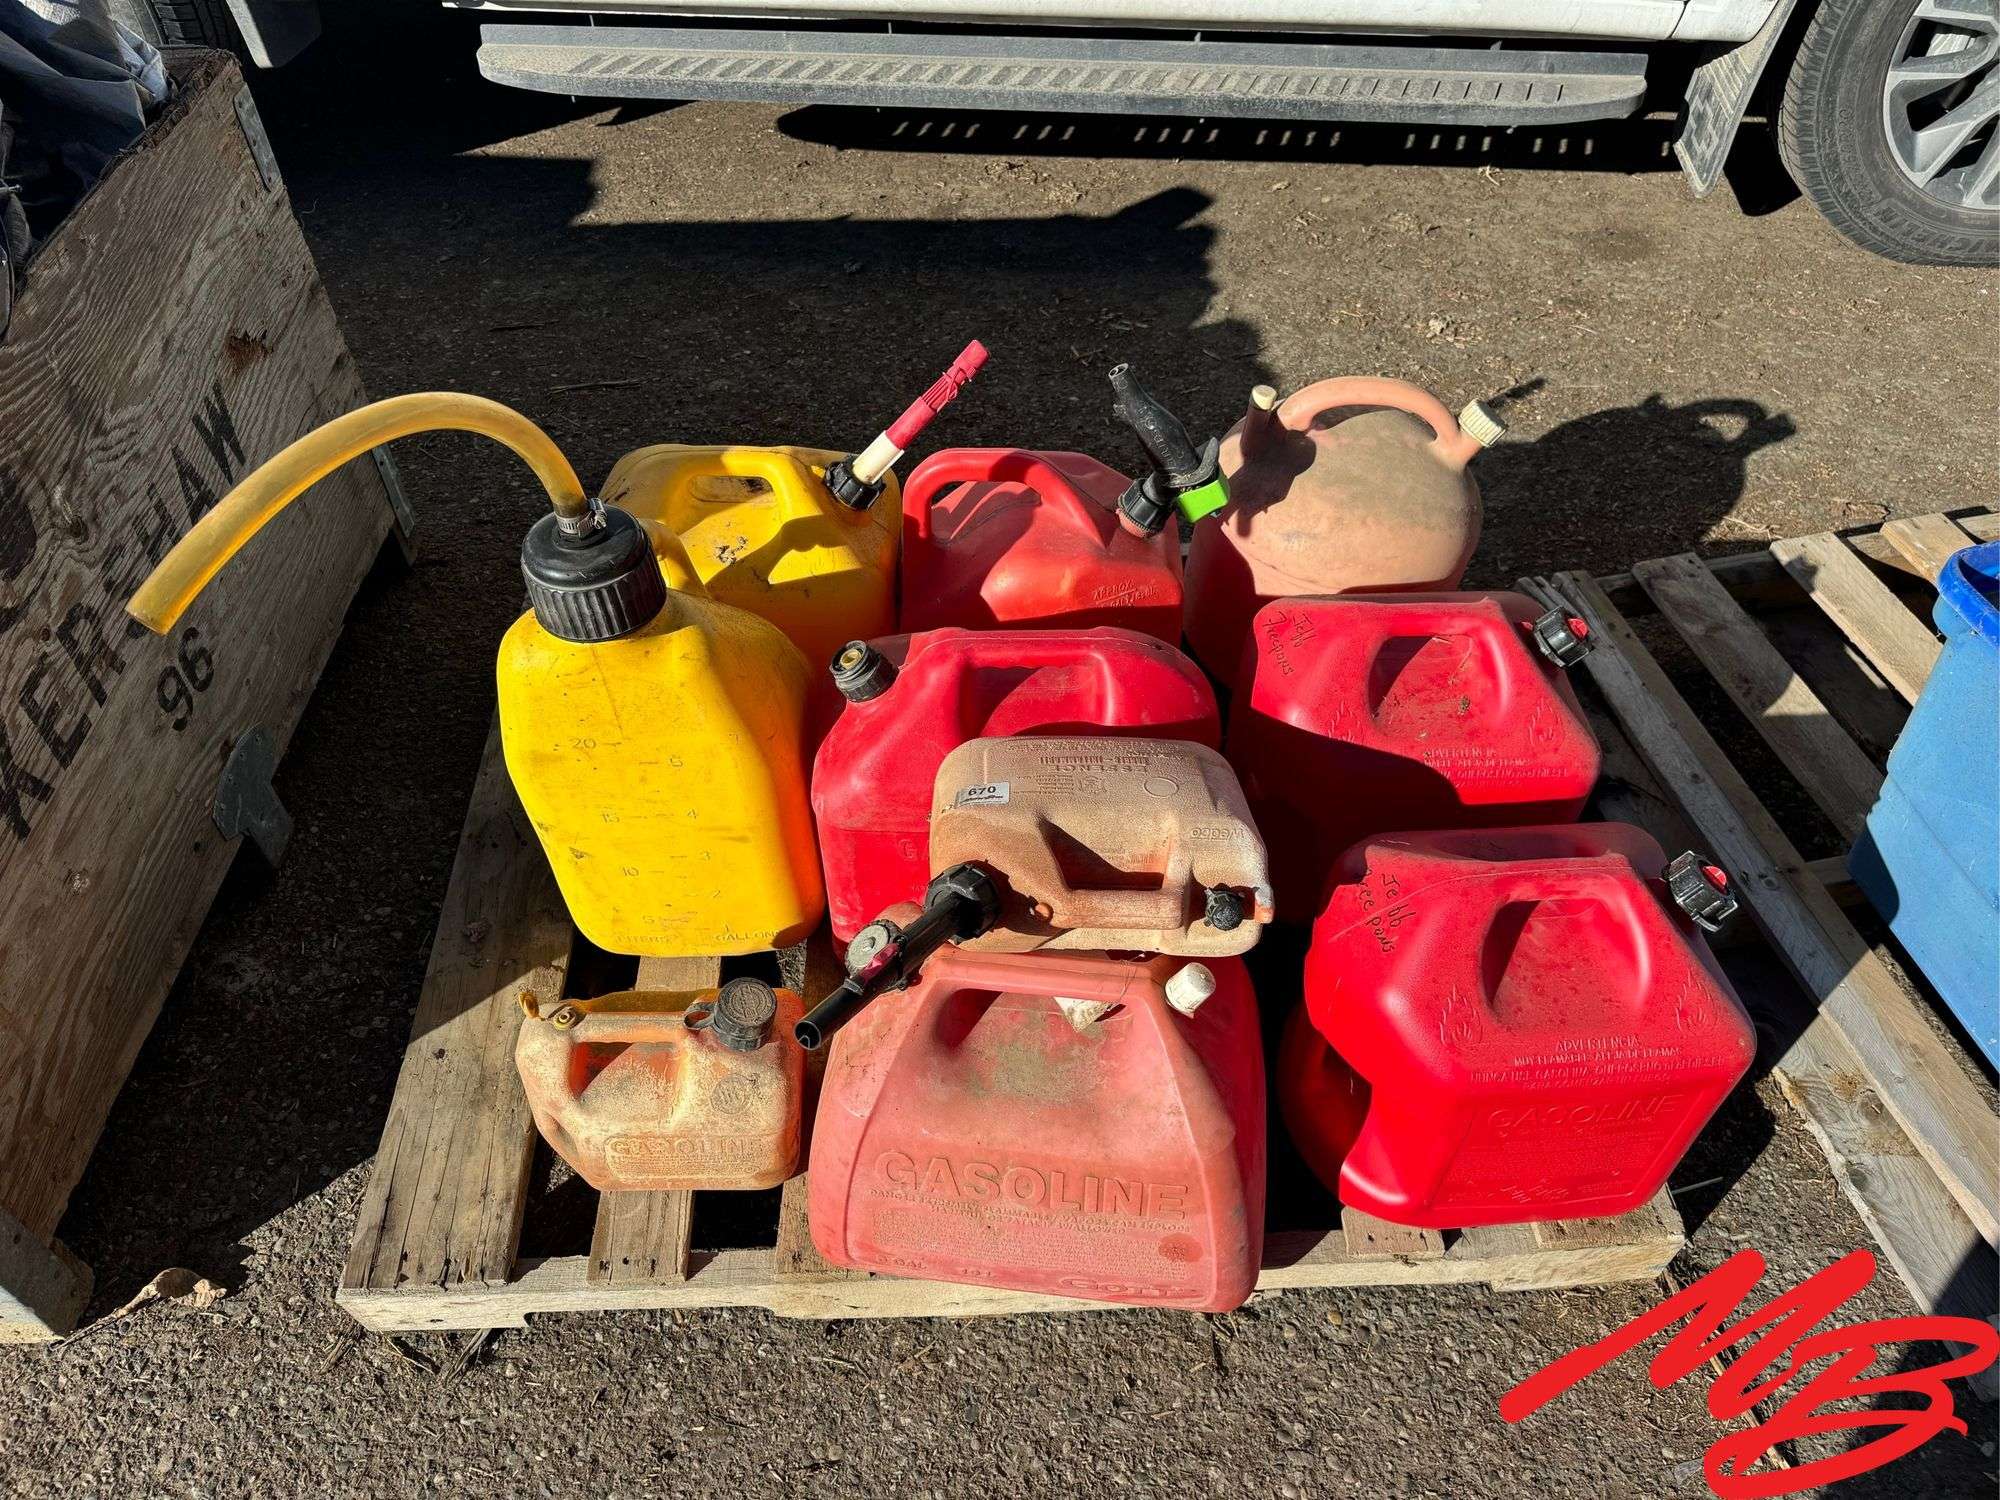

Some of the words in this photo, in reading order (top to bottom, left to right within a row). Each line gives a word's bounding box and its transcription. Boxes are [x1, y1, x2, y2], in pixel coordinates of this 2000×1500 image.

[156, 626, 215, 732] 96
[570, 737, 597, 750] 20
[968, 785, 997, 796] 670
[622, 867, 640, 878] 10
[1488, 1094, 1684, 1128] GASOLINE
[873, 1150, 1189, 1220] GASOLINE
